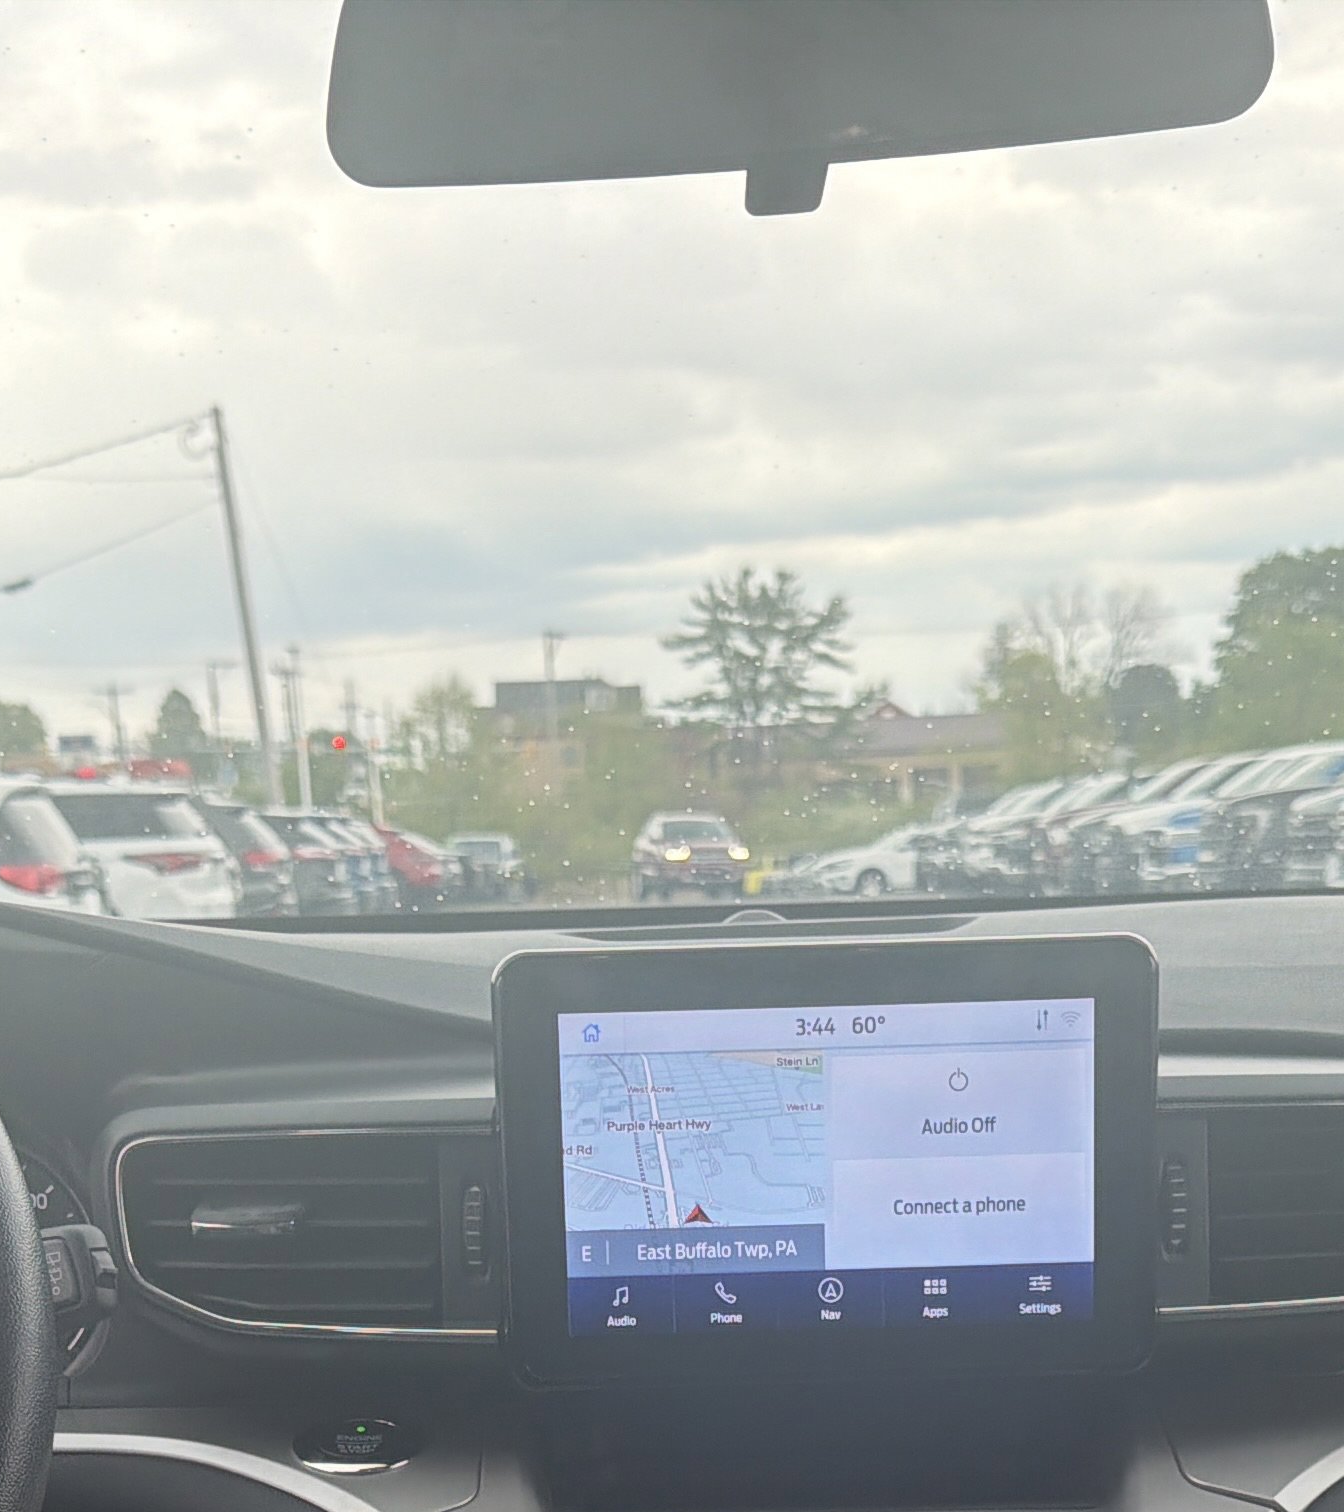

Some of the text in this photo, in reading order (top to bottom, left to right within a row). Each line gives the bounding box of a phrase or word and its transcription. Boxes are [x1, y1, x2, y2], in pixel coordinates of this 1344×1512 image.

[795, 1016, 836, 1036] 3:44
[776, 1056, 819, 1067] Stein Ln
[627, 1085, 675, 1094] West Acres
[786, 1103, 809, 1112] West
[607, 1119, 712, 1133] Purple Heart Hwy
[921, 1116, 997, 1135] Audio Off
[576, 1144, 593, 1156] Rd
[893, 1197, 1026, 1216] Connect a phone
[581, 1245, 592, 1263] E
[637, 1239, 798, 1261] East Buffalo Twp, PA
[820, 1309, 841, 1321] Nav
[922, 1306, 949, 1319] Apps
[1018, 1302, 1062, 1315] Settings
[606, 1315, 637, 1328] Audio
[710, 1312, 743, 1324] Phone
